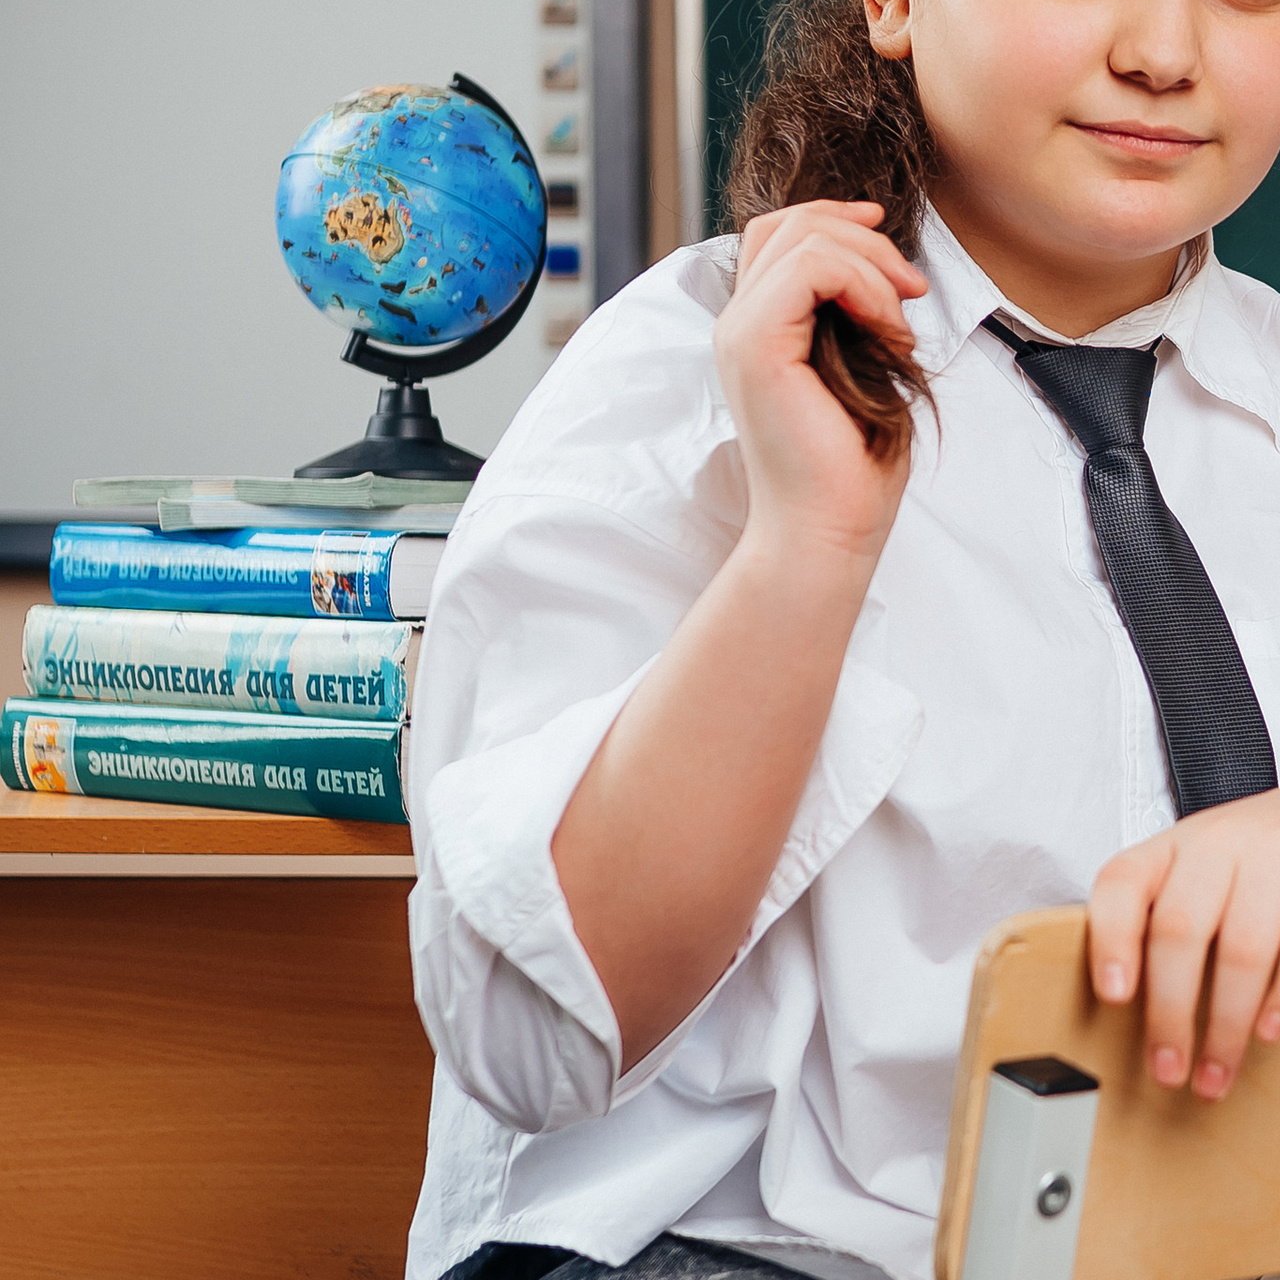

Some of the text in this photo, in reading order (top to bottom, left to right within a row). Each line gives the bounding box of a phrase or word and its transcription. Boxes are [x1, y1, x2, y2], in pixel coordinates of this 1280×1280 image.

[45, 658, 387, 707] ЭНЦИКЛОПЕДИЯ ДЛЯ ДЕТЕЙ
[87, 749, 387, 799] ЭНЦИКЛОПЕДИЯ ДЛЯ ДЕТЕЙ
